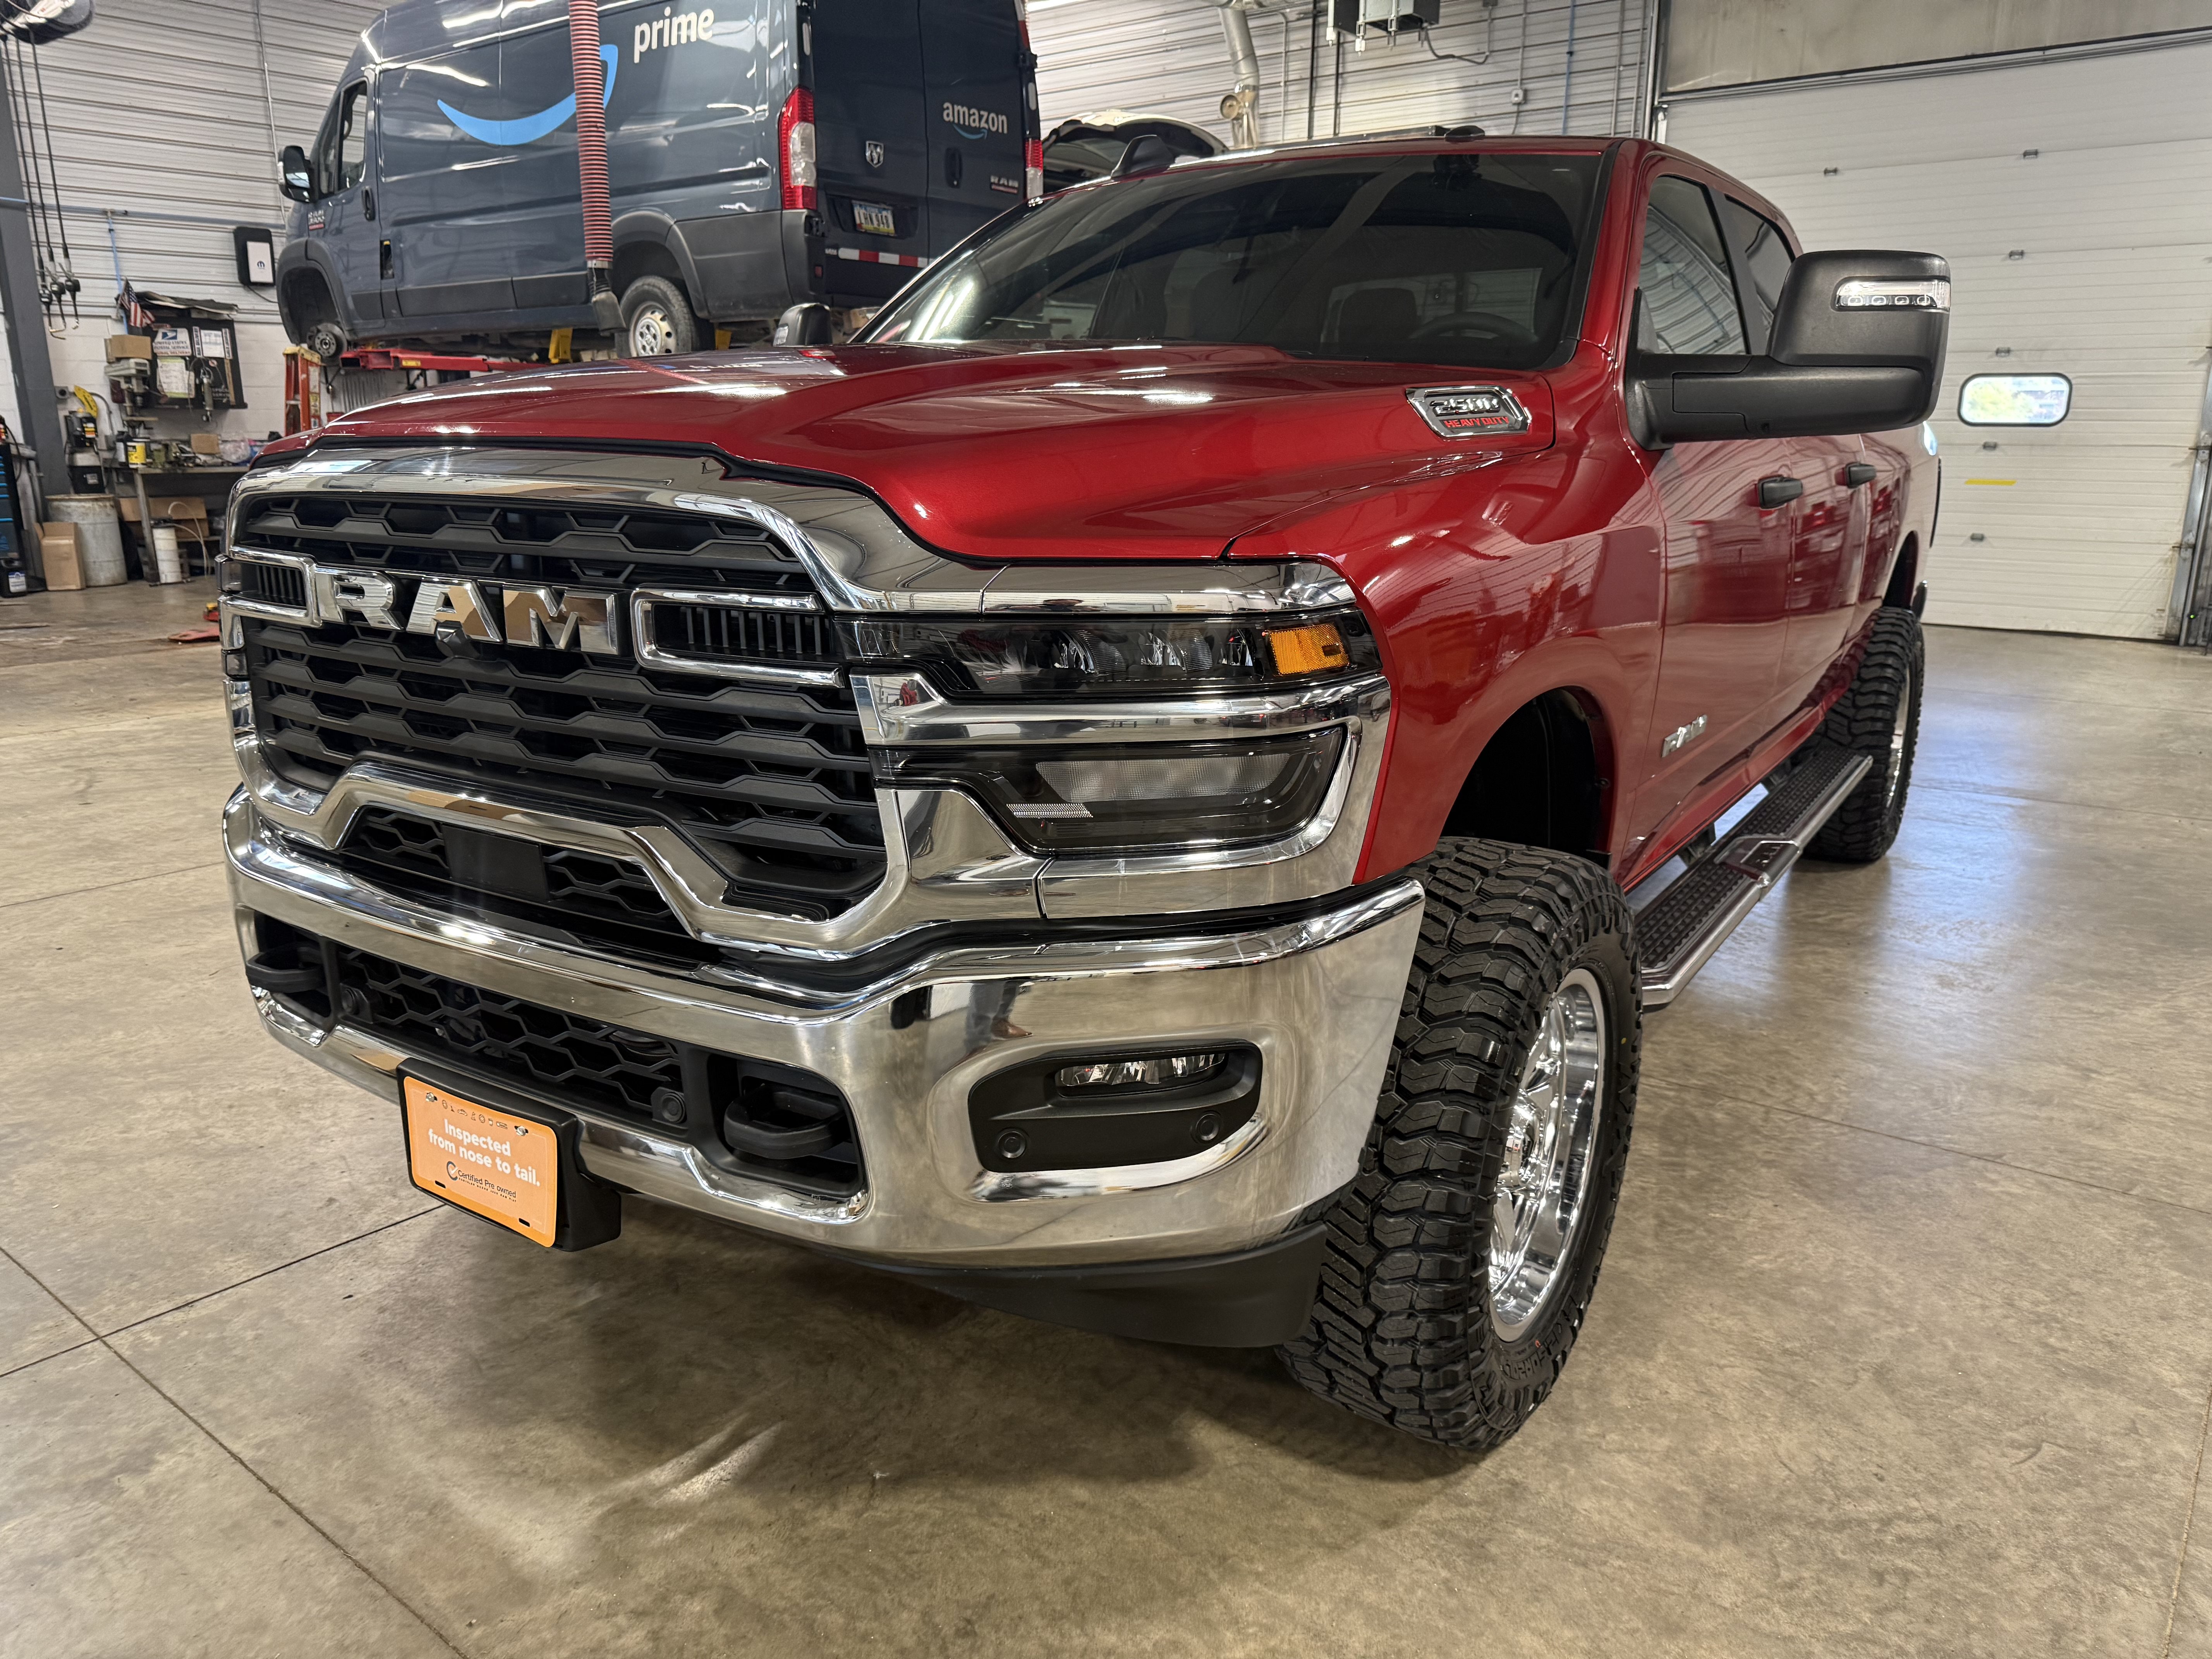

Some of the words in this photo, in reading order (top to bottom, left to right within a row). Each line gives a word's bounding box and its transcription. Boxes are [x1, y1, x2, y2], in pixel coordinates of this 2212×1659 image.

[634, 6, 714, 64] prime
[943, 102, 1008, 134] amazon
[990, 175, 1019, 187] RAM
[1443, 418, 1481, 428] HEAVY
[1480, 416, 1510, 426] DUTY
[315, 567, 619, 655] RAM
[444, 1118, 511, 1157] Inspected
[428, 1128, 456, 1154] from
[459, 1146, 492, 1168] nose
[495, 1157, 511, 1175] to
[514, 1163, 541, 1187] tail.
[458, 1170, 483, 1185] Certified
